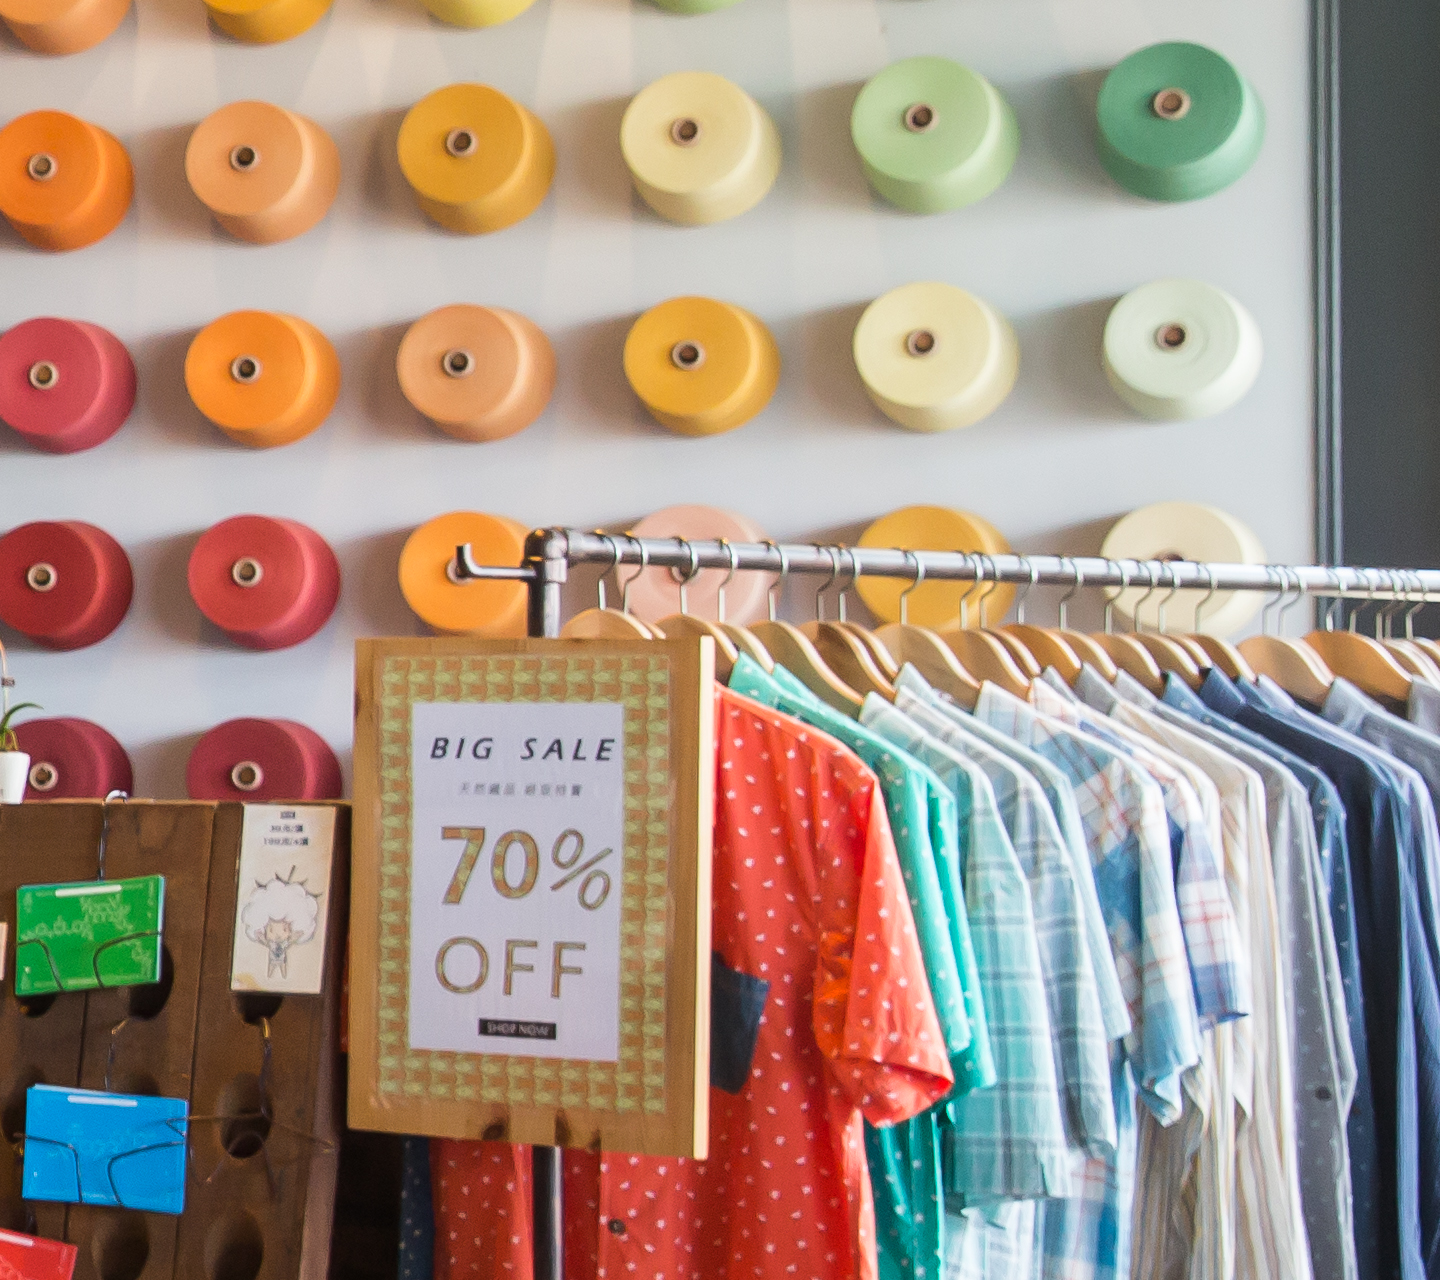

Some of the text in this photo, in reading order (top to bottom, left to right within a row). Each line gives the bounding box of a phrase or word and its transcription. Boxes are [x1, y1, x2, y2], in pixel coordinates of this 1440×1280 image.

[430, 736, 617, 762] BIG SALE
[440, 826, 613, 911] 70%
[434, 937, 587, 999] OFF
[486, 1021, 549, 1037] SHOP NOW
